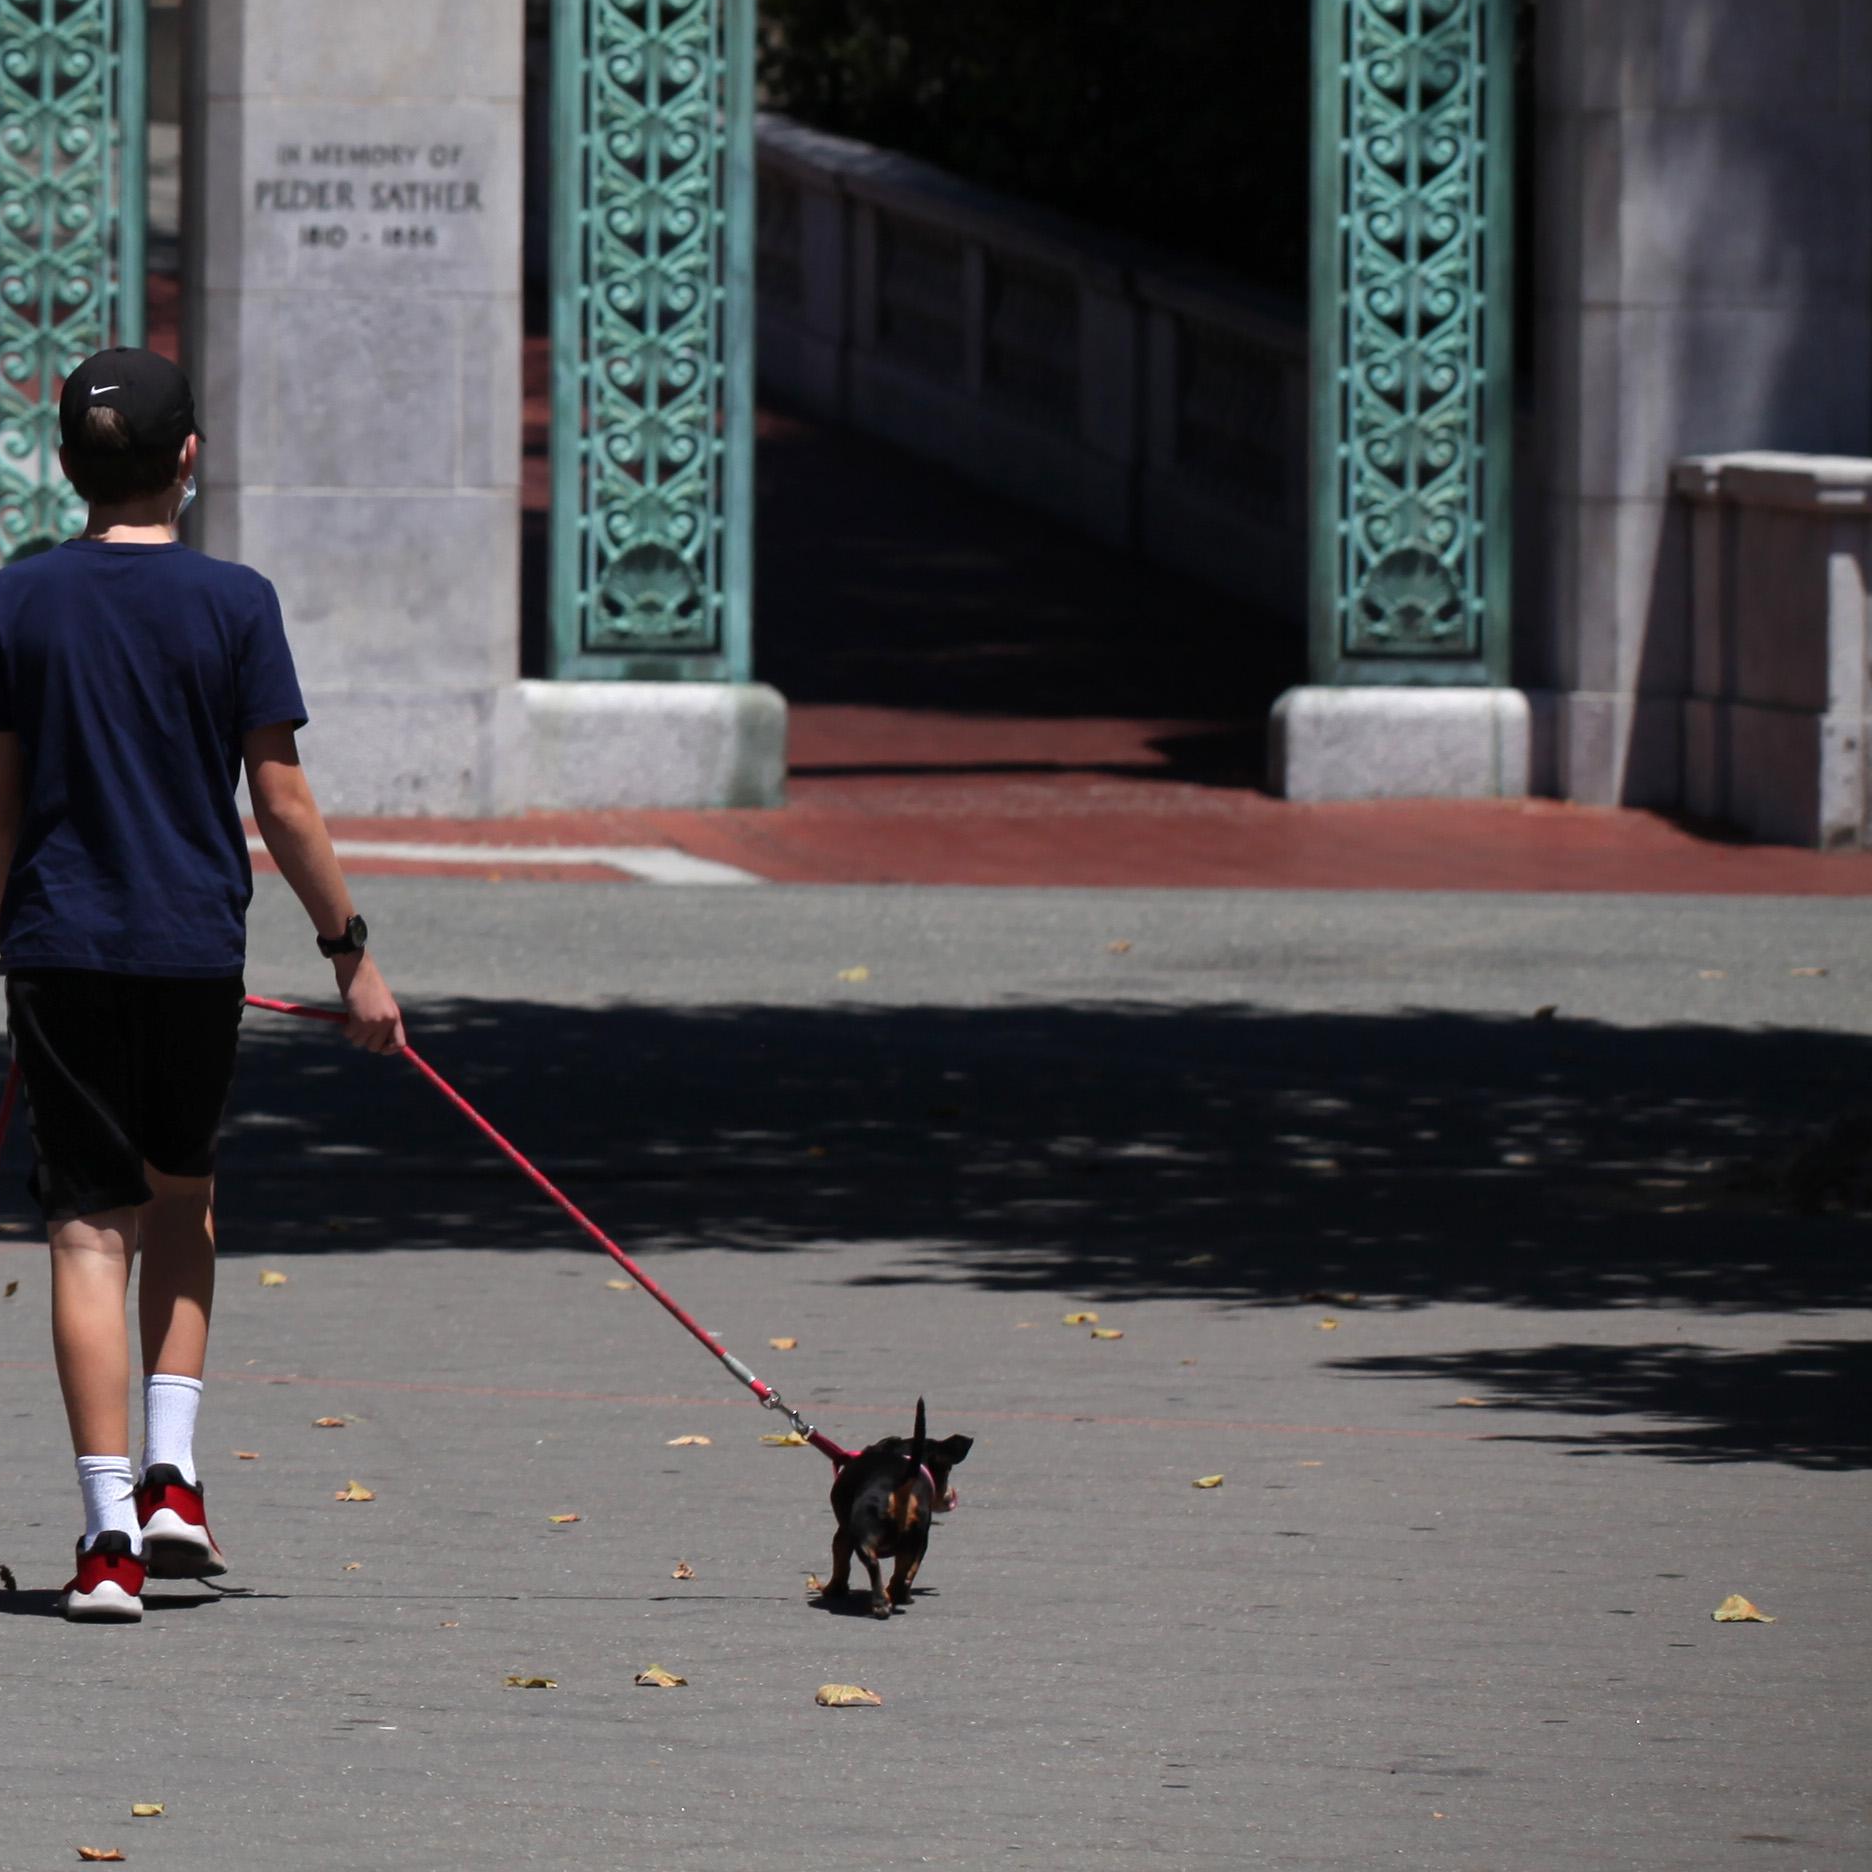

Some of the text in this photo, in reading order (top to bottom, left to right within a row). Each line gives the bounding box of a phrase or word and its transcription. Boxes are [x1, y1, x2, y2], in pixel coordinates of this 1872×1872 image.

[277, 143, 464, 168] IN MEMORY OF
[255, 179, 483, 214] PEDER SATHER
[298, 224, 349, 249] 1810
